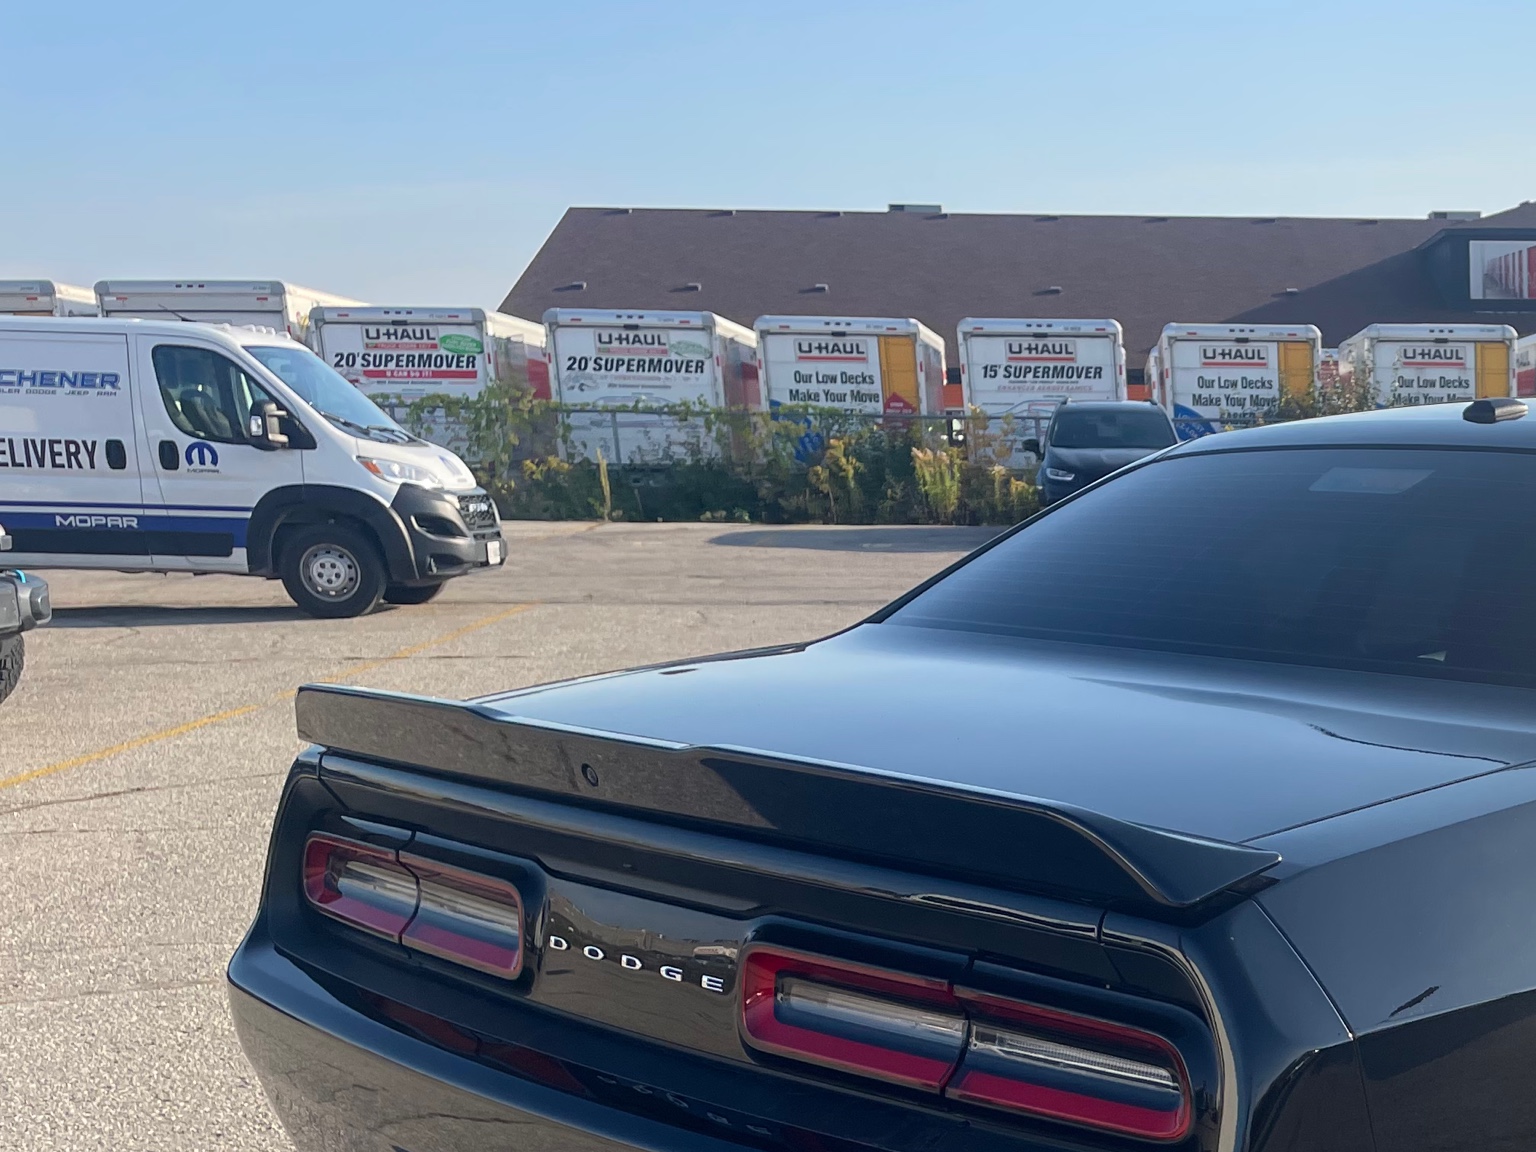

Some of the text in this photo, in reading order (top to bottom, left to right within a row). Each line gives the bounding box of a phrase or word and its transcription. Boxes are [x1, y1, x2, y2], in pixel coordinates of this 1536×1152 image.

[365, 328, 436, 341] U-HAUL
[598, 333, 667, 346] U-HAUL
[798, 342, 865, 354] U-HAUL
[1008, 343, 1074, 355] U-HAUL
[1203, 348, 1265, 360] U-HAUL
[1404, 349, 1463, 360] U-HAUL
[334, 352, 477, 369] 20' SUPERMOVER
[567, 356, 705, 374] 20' SUPERMOVER
[794, 370, 874, 385] Our Low Decks
[982, 364, 1102, 379] 15' SUPERMOVER
[0, 369, 121, 390] CHENER
[1197, 376, 1273, 390] Our Low Decks
[1398, 376, 1470, 389] Our Low Decks
[789, 389, 880, 403] Make Your Move
[1192, 394, 1221, 406] Make
[1249, 395, 1278, 407] Move
[55, 515, 138, 529] MOPAR
[549, 935, 724, 992] DODGE
